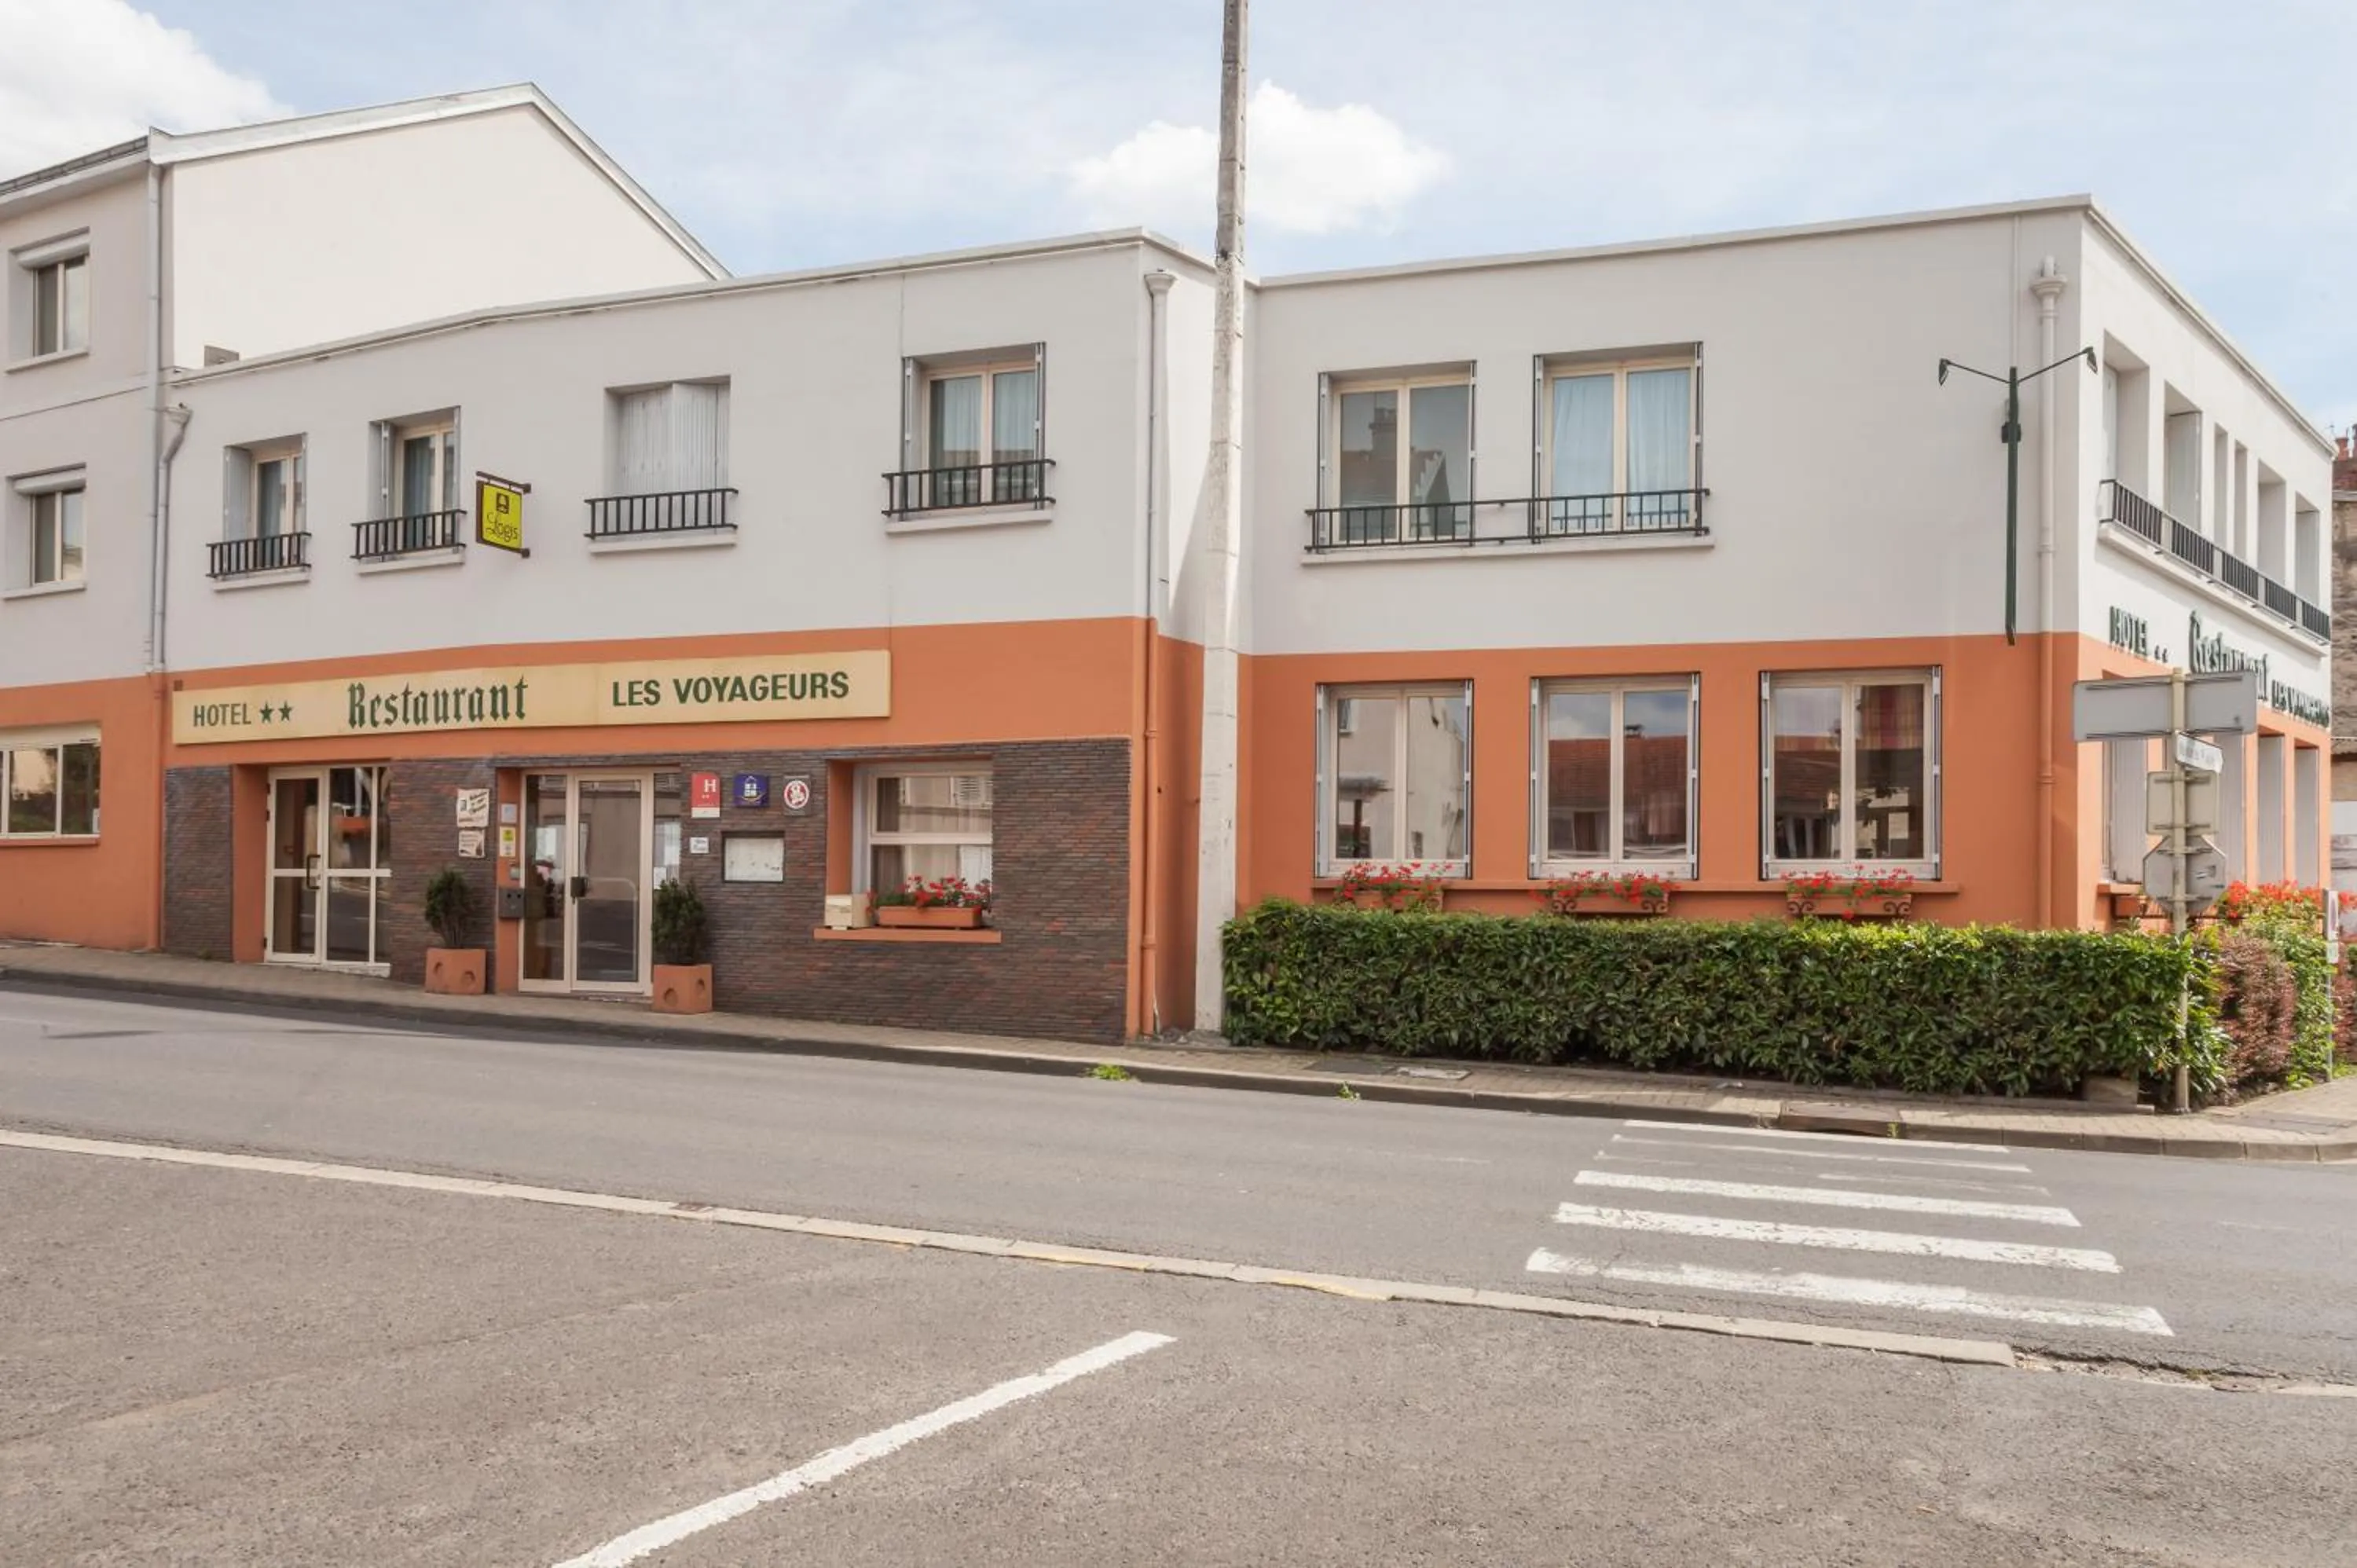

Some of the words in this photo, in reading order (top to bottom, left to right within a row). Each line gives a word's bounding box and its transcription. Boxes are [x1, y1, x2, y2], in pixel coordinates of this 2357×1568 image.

[193, 702, 251, 727] HOTEL
[347, 674, 529, 729] Restaurant
[613, 680, 661, 706] LES
[673, 672, 849, 705] VOYAGEURS
[704, 779, 717, 793] H
